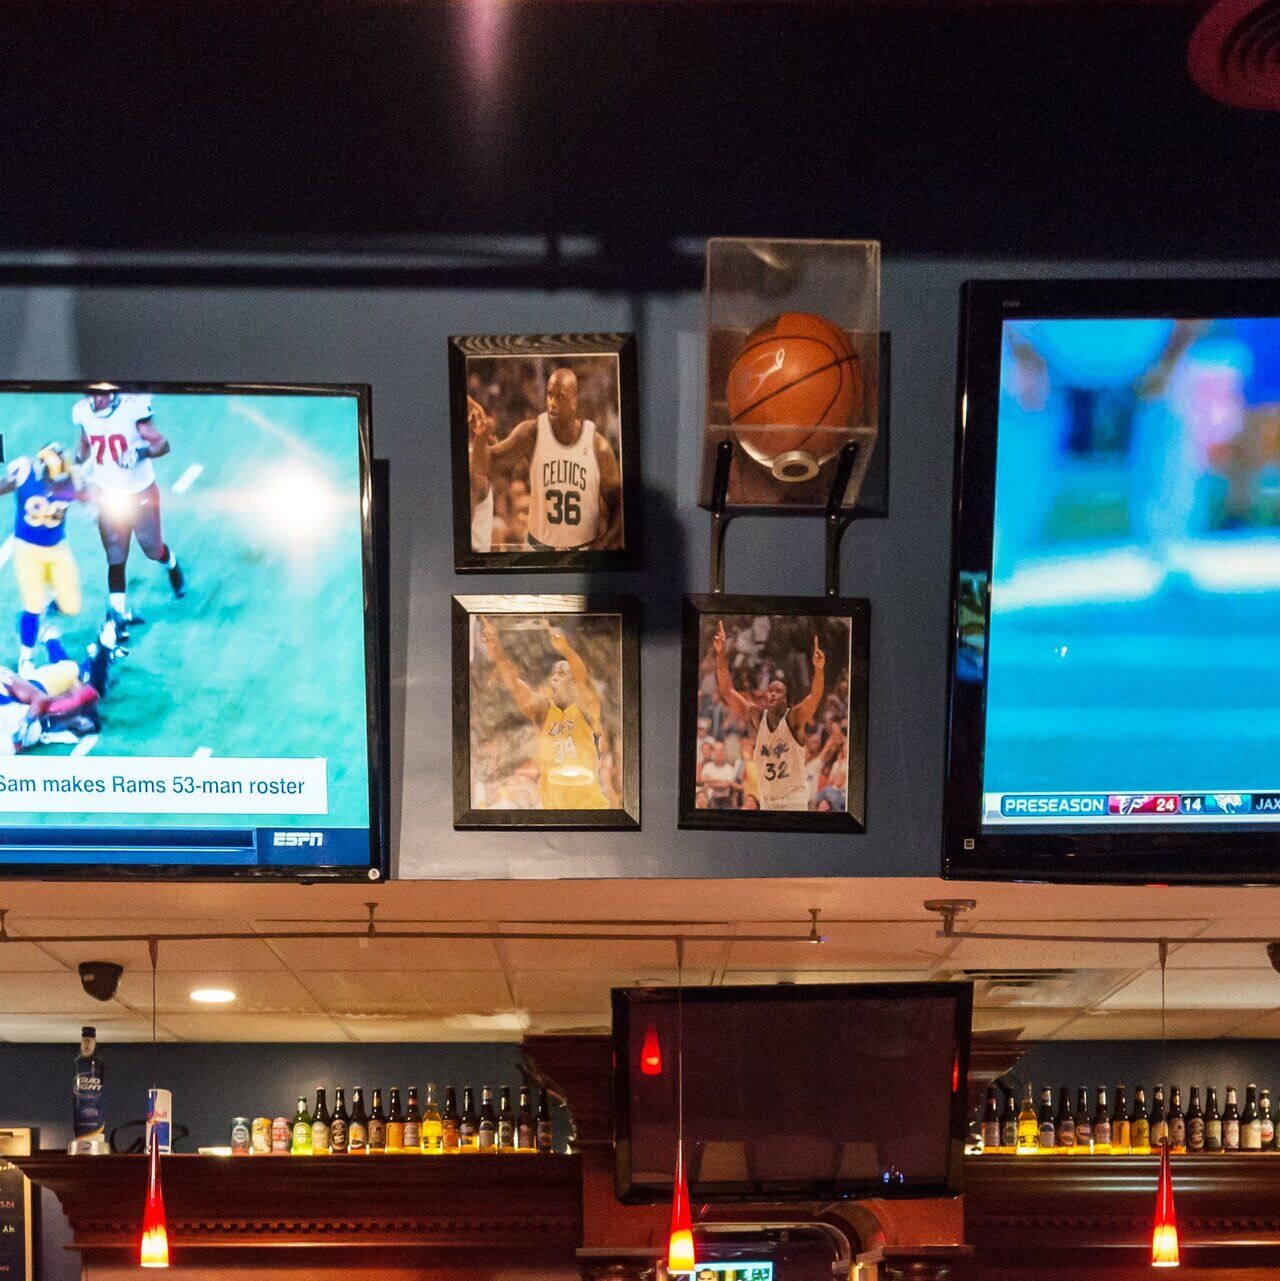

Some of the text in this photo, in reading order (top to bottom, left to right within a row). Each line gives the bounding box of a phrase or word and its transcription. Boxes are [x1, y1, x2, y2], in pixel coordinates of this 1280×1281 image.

[90, 434, 127, 466] 70
[543, 460, 587, 491] CELTICS
[546, 489, 581, 525] 36
[765, 761, 790, 781] 32
[43, 775, 106, 793] makes
[112, 776, 166, 794] Rams
[173, 776, 243, 795] 53-man
[249, 778, 305, 795] roster
[1005, 798, 1104, 812] PRESEASON
[1156, 799, 1175, 812] 24
[1184, 798, 1202, 811] 14
[273, 832, 324, 847] ESPN
